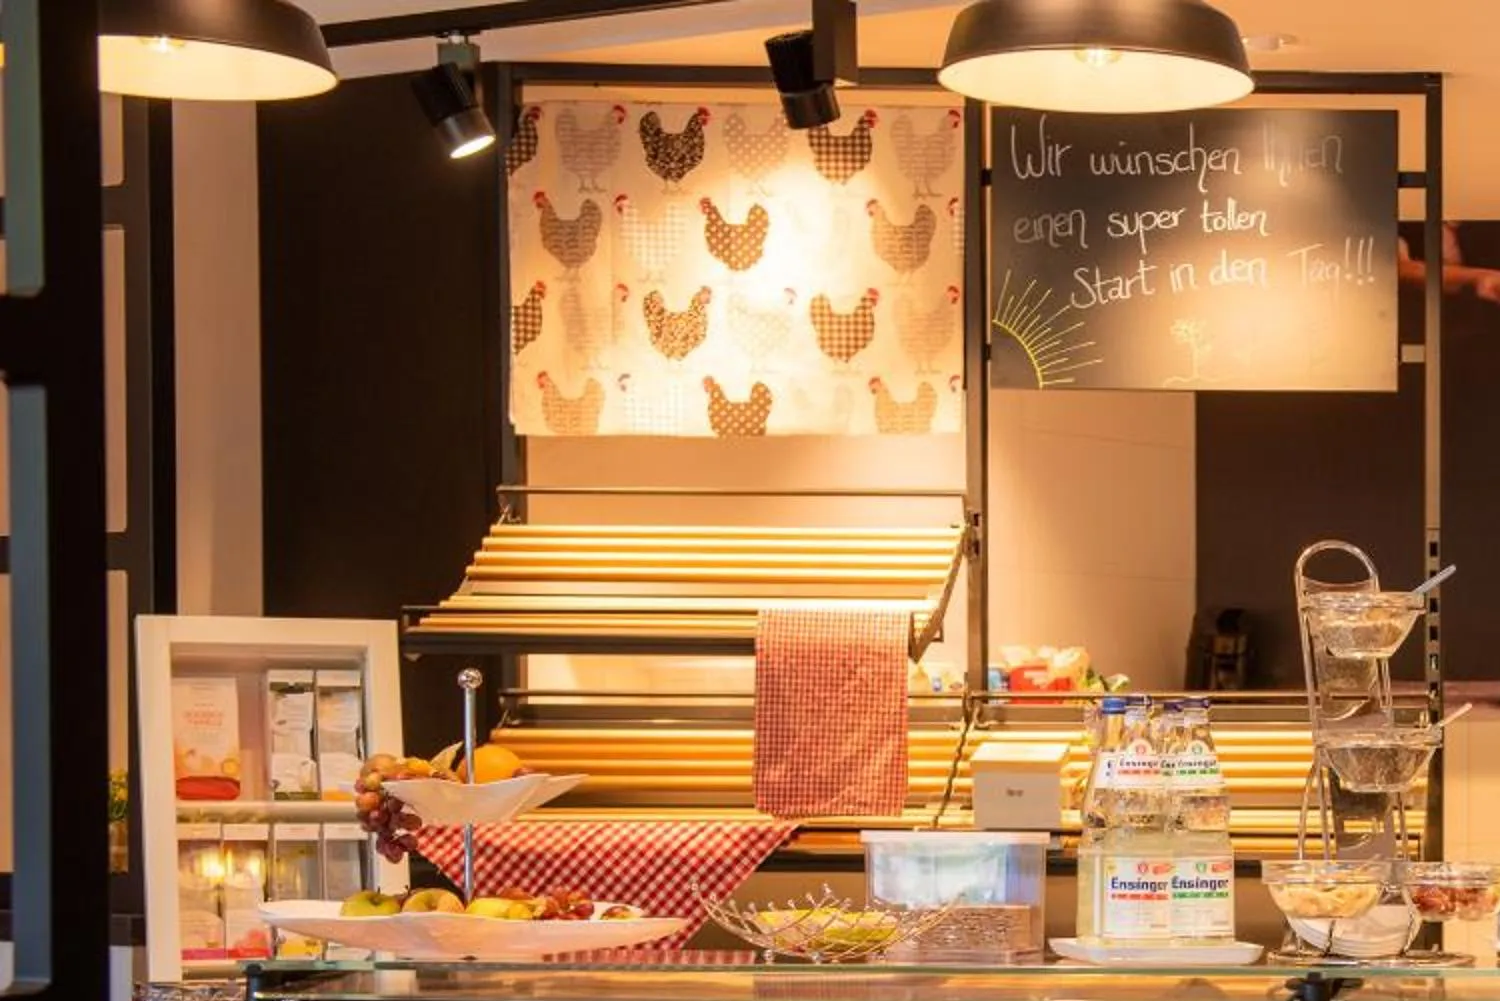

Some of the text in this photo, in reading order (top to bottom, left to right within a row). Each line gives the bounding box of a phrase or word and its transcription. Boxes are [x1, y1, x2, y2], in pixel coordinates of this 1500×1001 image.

[1010, 114, 1073, 179] Wir
[1013, 197, 1269, 254] einen super tollen
[1070, 259, 1158, 310] Start
[1169, 263, 1198, 293] in
[1208, 249, 1268, 288] den
[1111, 877, 1169, 892] Ensinger
[1171, 876, 1229, 891] Ensinger
